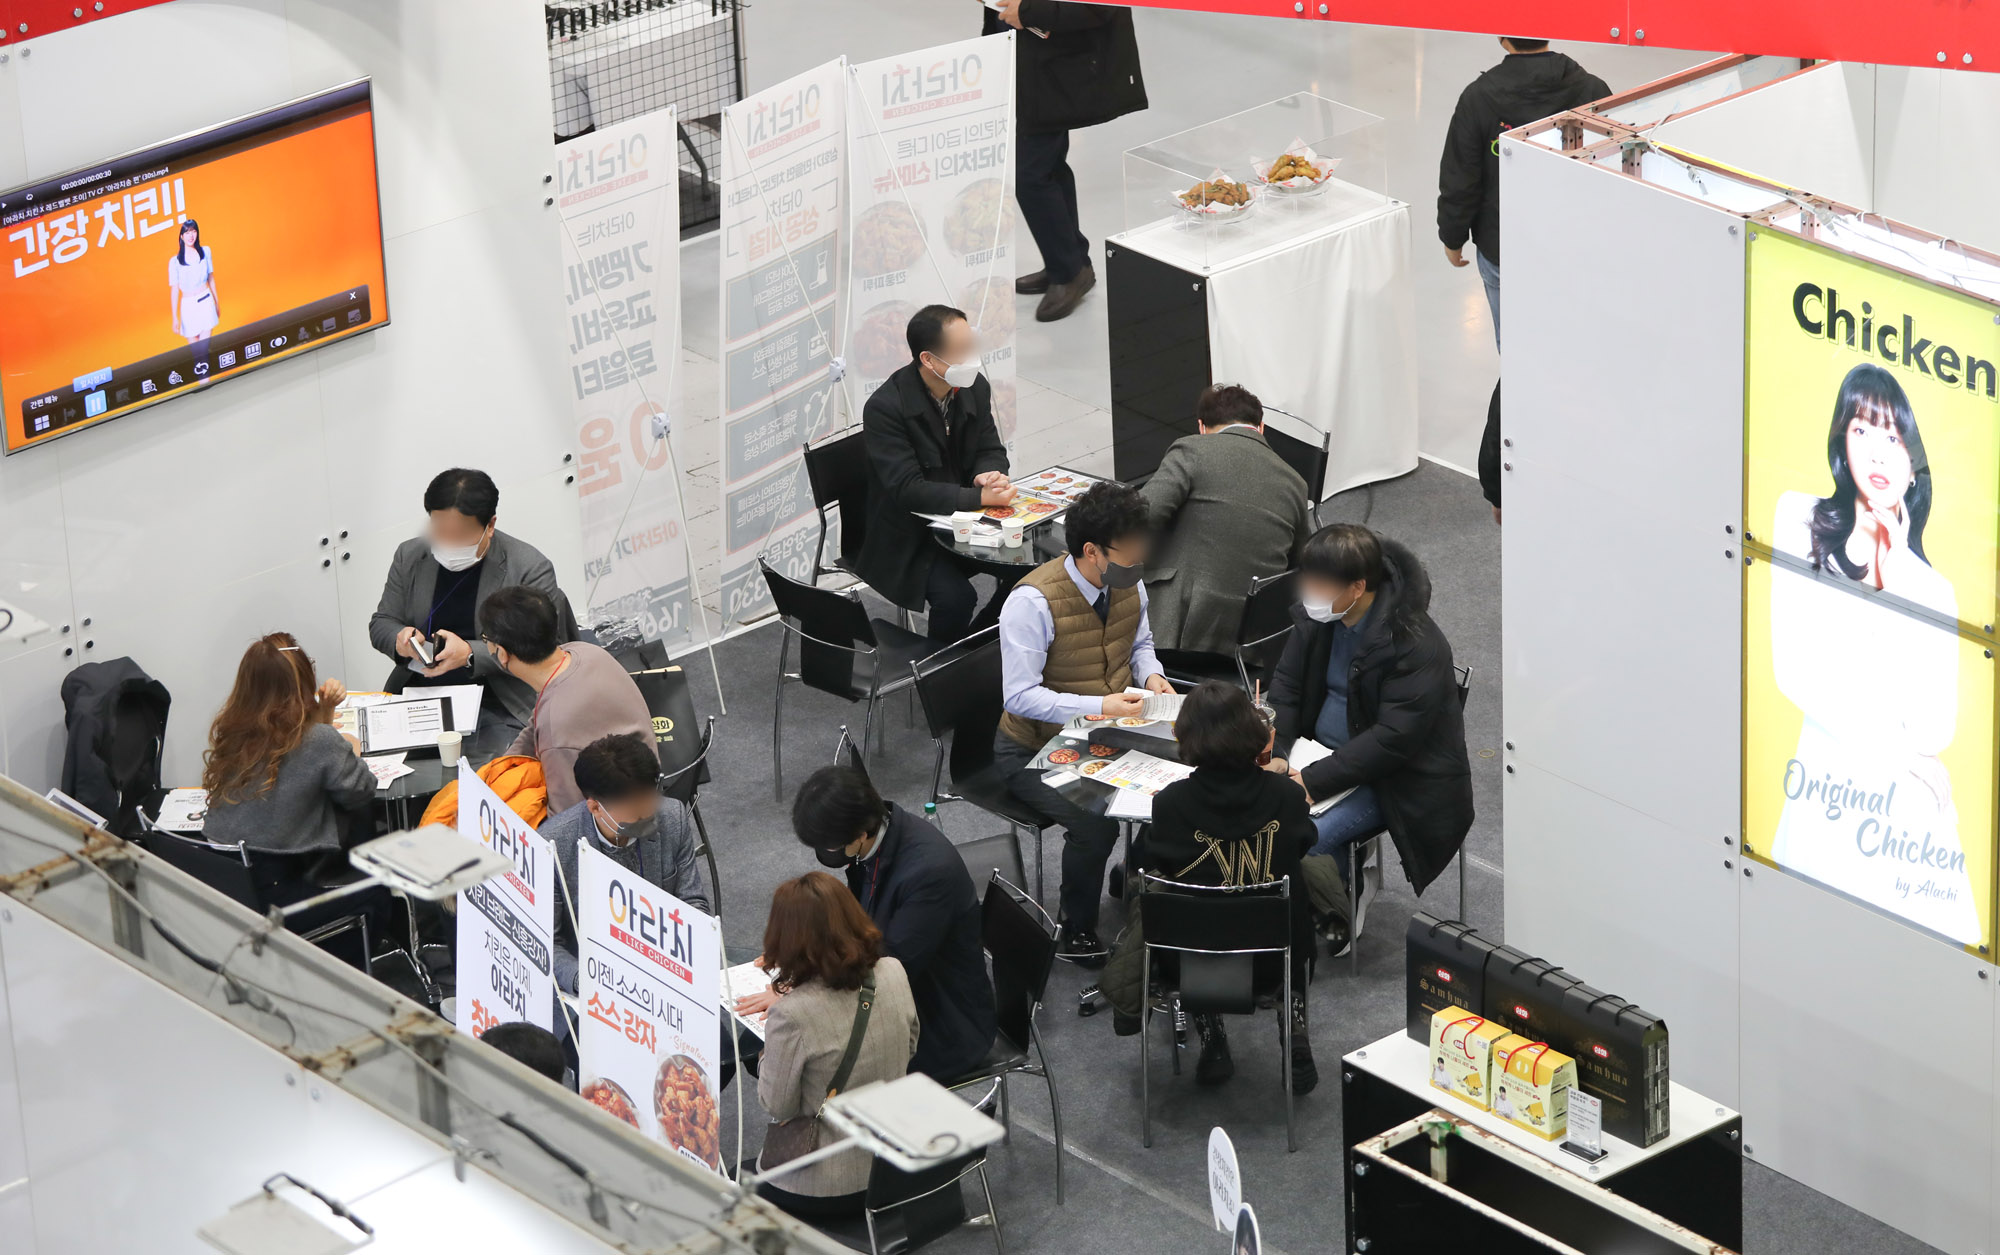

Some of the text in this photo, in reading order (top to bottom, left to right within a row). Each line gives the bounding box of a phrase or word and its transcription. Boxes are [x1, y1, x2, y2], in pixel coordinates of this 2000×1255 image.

[61, 169, 112, 191] 00:00:00/00:00:30
[87, 190, 97, 198] TV
[96, 187, 105, 195] CF
[9, 178, 187, 279] 간장 치킨!
[1793, 282, 1998, 402] Chicken
[30, 394, 59, 410] 간편 메뉴
[1783, 759, 1896, 820] Original
[480, 799, 535, 889] 아라치
[1856, 818, 1966, 873] Chicken
[1895, 877, 1911, 898] by
[486, 896, 511, 930] 브랜드
[512, 918, 548, 972] 신흥강자!
[609, 879, 693, 967] 아라치
[484, 929, 511, 975] 치킨은
[625, 934, 645, 953] LIKE
[648, 945, 686, 979] CHICKEN
[472, 999, 500, 1039] 창
[491, 963, 526, 1021] 아라치
[588, 956, 684, 1034] 이젠 소스의 시대
[1420, 978, 1469, 1010] Samhwa
[587, 991, 657, 1055] 소스 강자
